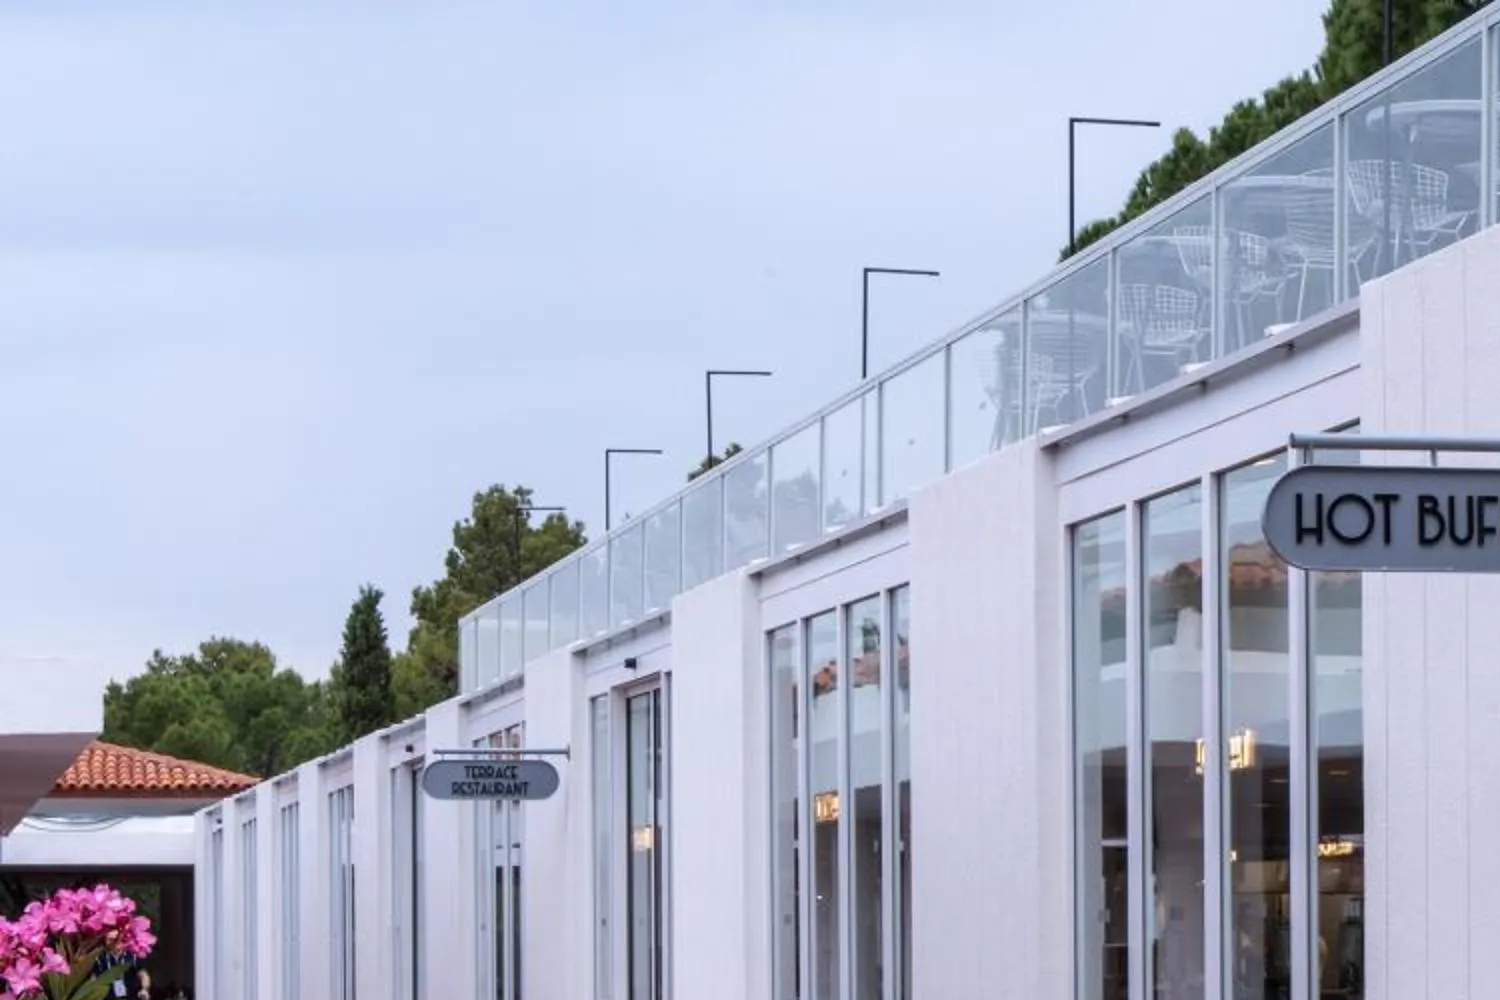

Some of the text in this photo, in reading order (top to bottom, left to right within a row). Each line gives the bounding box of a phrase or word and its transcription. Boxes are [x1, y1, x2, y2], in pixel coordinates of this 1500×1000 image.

[1295, 493, 1399, 547] HOT
[465, 766, 518, 779] TERRACE
[452, 781, 529, 796] RESTAURANT
